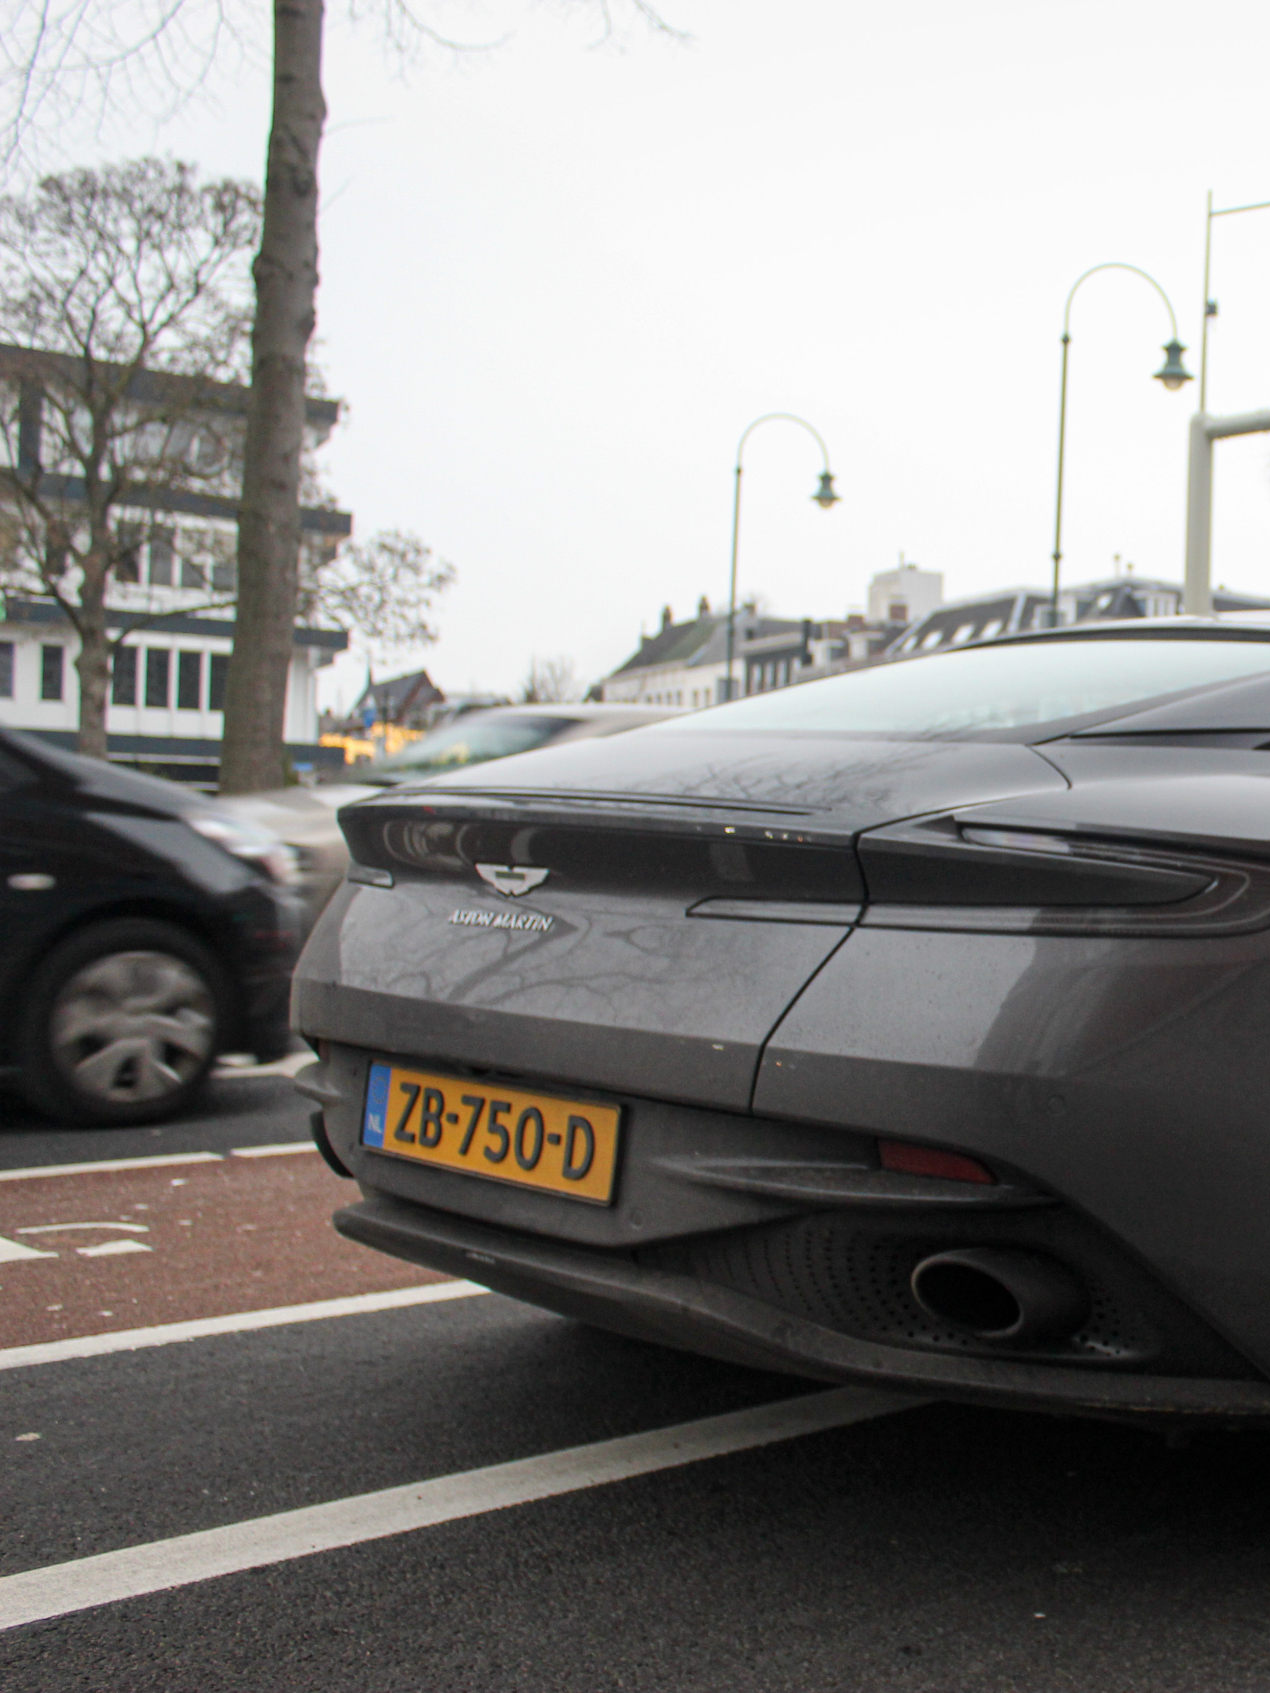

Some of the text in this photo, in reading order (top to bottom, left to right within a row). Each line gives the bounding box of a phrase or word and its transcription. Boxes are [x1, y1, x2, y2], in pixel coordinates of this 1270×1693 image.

[449, 910, 554, 931] ASTON MARTIN
[367, 1112, 383, 1134] NL
[394, 1082, 595, 1180] ZB-750-D
